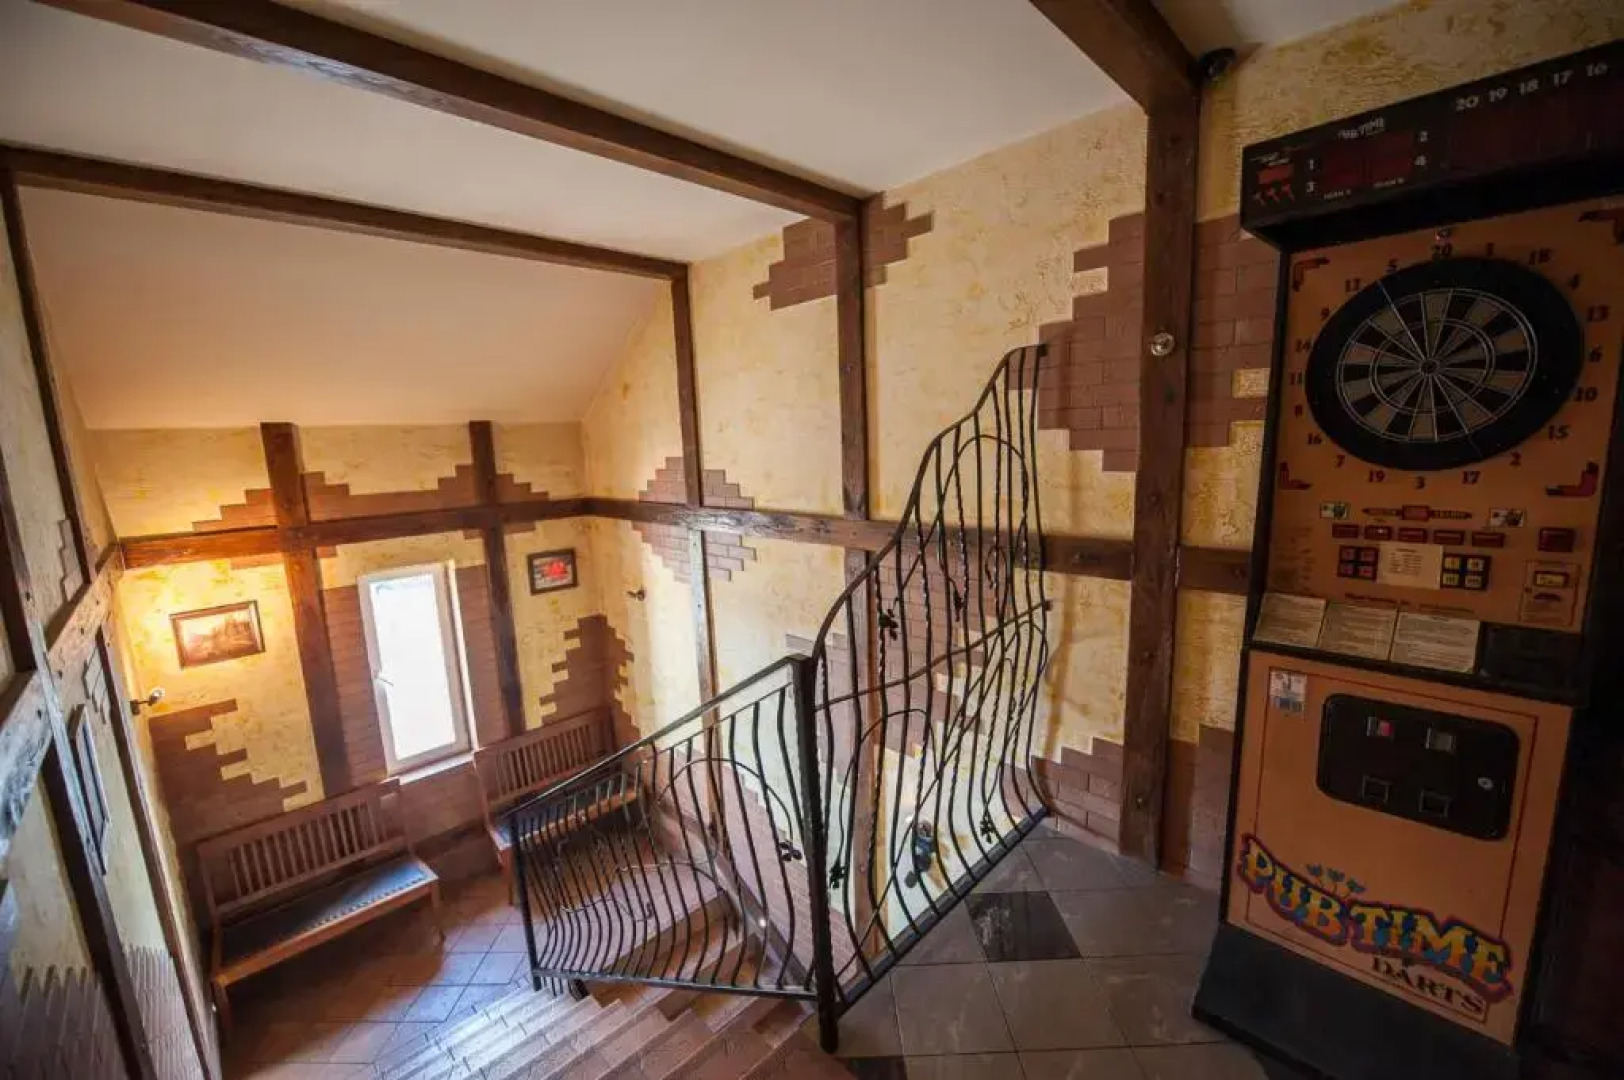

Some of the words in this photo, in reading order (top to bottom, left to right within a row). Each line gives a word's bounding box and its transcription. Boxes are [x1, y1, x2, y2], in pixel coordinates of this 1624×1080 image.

[1456, 94, 1480, 112] 20
[1488, 85, 1508, 103] 19
[1518, 77, 1539, 96] 18
[1553, 69, 1574, 88] 17
[1585, 62, 1609, 77] 16
[1418, 129, 1429, 143] 2
[1308, 158, 1316, 171] 1
[1306, 180, 1316, 194] 3
[1387, 258, 1398, 273] 5
[1307, 432, 1322, 445] 16
[1548, 425, 1570, 441] 15
[1336, 454, 1345, 468] 7
[1509, 451, 1521, 466] 2
[1368, 470, 1386, 483] 19
[1416, 476, 1425, 490] 3
[1461, 470, 1481, 484] 17
[1240, 837, 1346, 943] PUB
[1351, 901, 1510, 994] TIME
[1372, 956, 1485, 1014] DARTS
